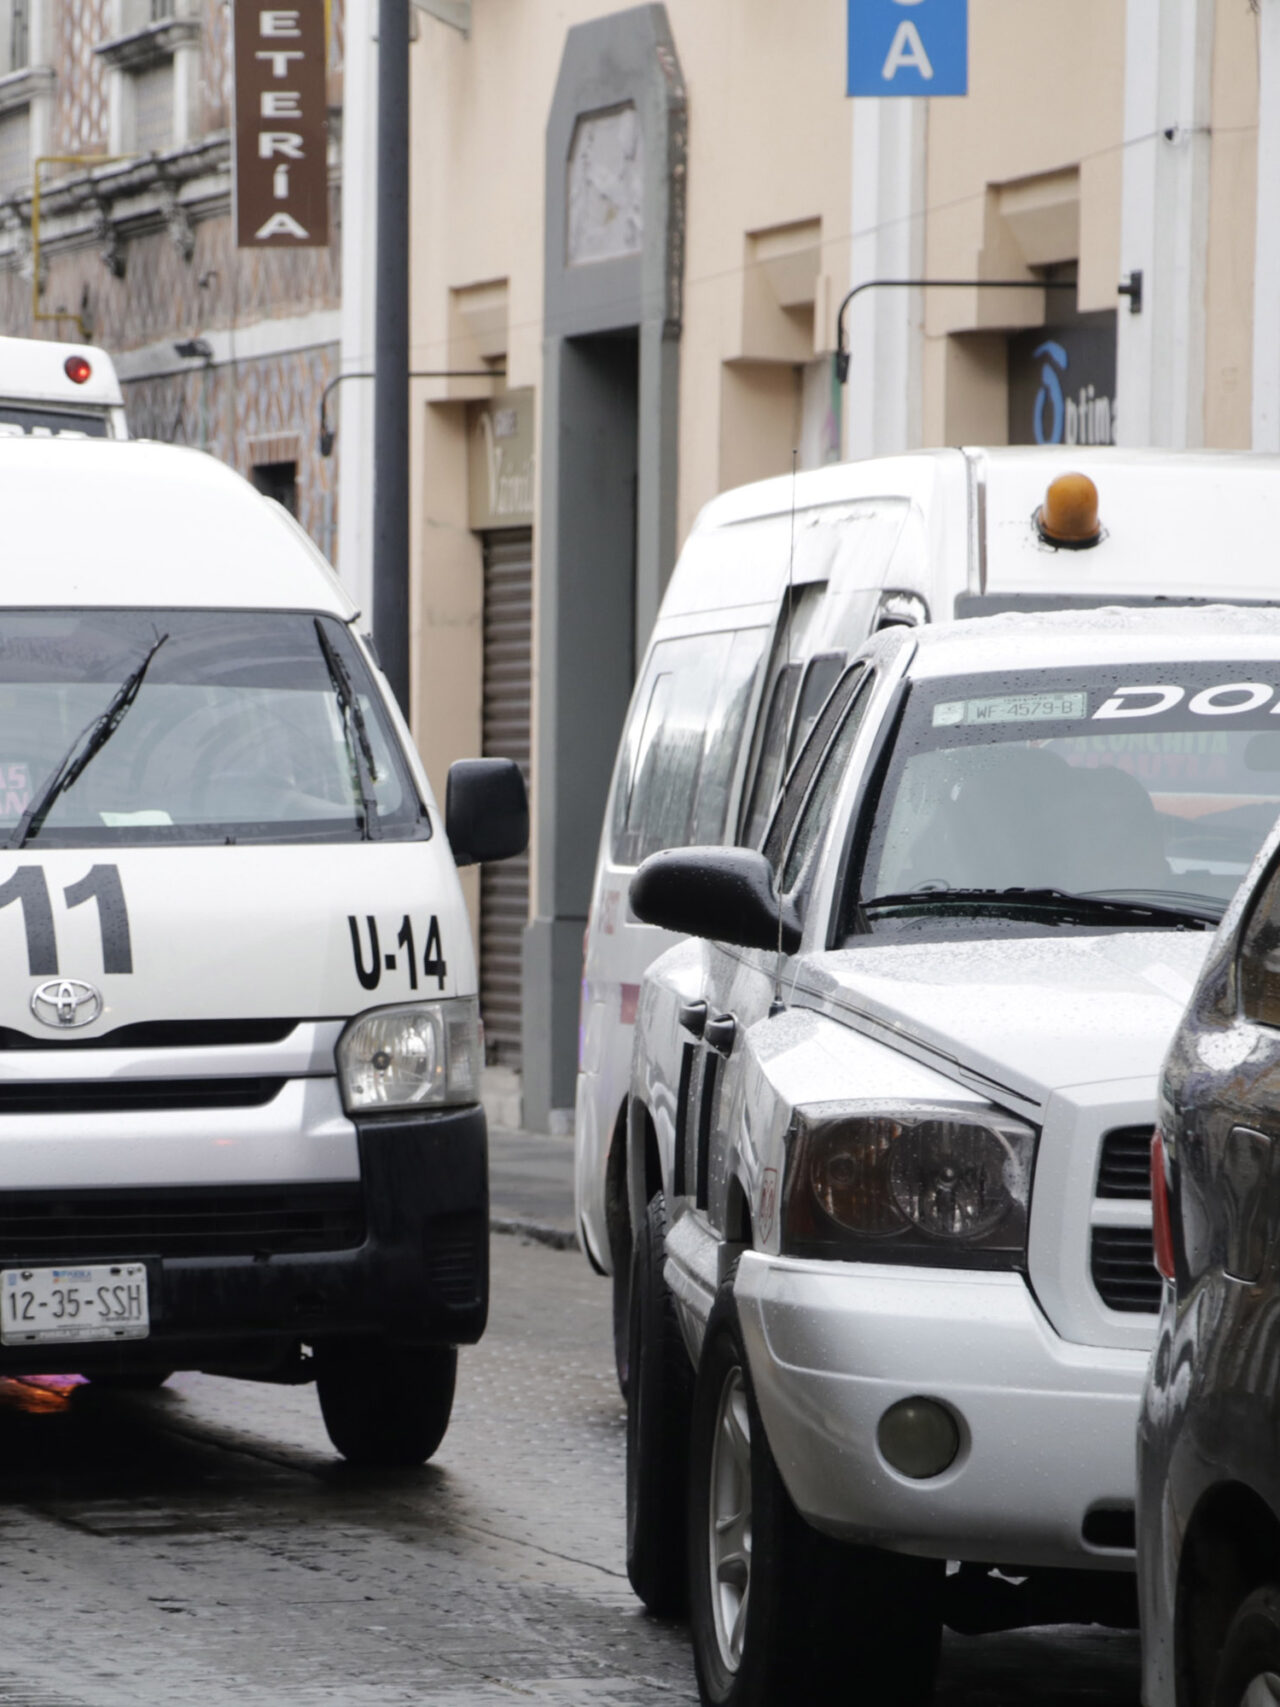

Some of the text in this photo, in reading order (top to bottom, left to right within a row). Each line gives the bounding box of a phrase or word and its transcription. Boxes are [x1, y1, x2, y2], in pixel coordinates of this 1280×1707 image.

[881, 0, 934, 82] A
[1091, 682, 1280, 719] DO
[348, 913, 448, 992] U-14
[9, 1284, 142, 1321] 12-35-SSH
